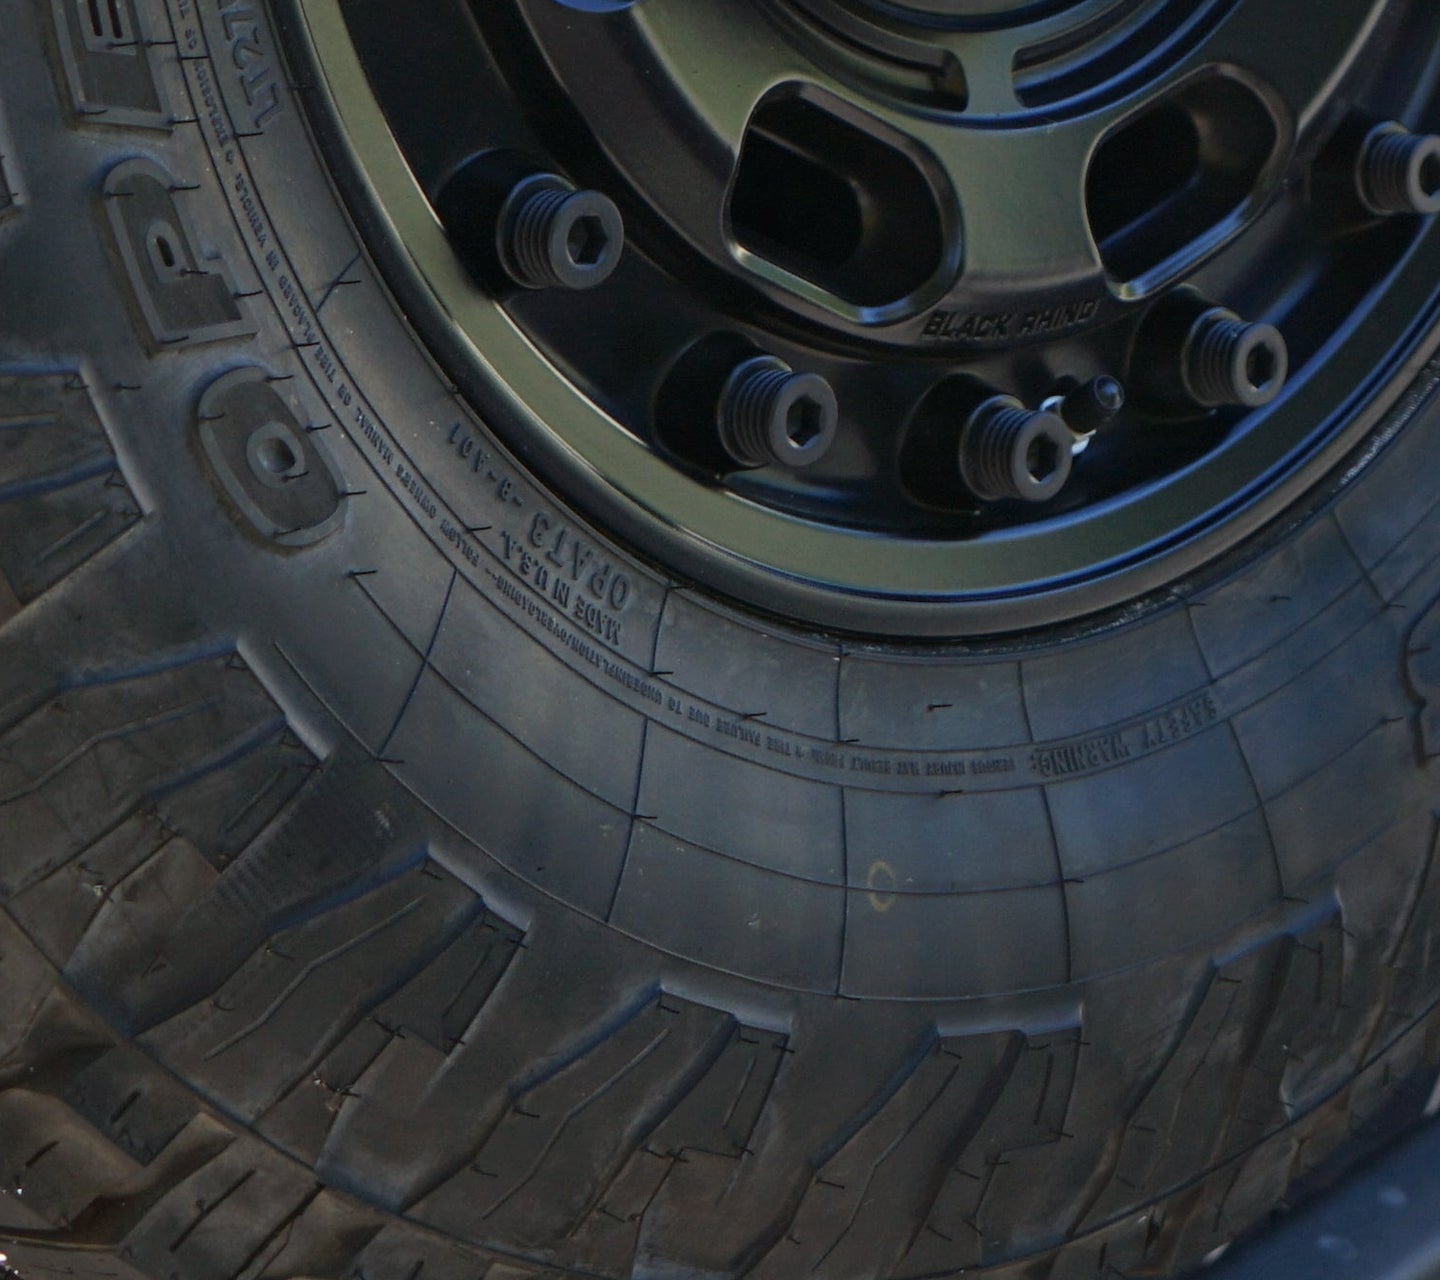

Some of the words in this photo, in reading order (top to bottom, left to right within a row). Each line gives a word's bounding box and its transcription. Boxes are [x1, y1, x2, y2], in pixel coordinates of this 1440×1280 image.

[183, 25, 200, 49] OF
[192, 57, 230, 148] EXPLOSION
[263, 249, 281, 271] IN
[920, 309, 1011, 339] BLACK
[334, 381, 356, 407] OR
[349, 405, 397, 466] MANUAL
[489, 527, 558, 592] U.S.A.
[544, 576, 577, 609] IN
[565, 593, 628, 646] MADE
[663, 694, 686, 715] TO
[684, 704, 714, 728] DUE
[1136, 694, 1220, 750] SAFETY
[1029, 731, 1130, 779] WARNING:
